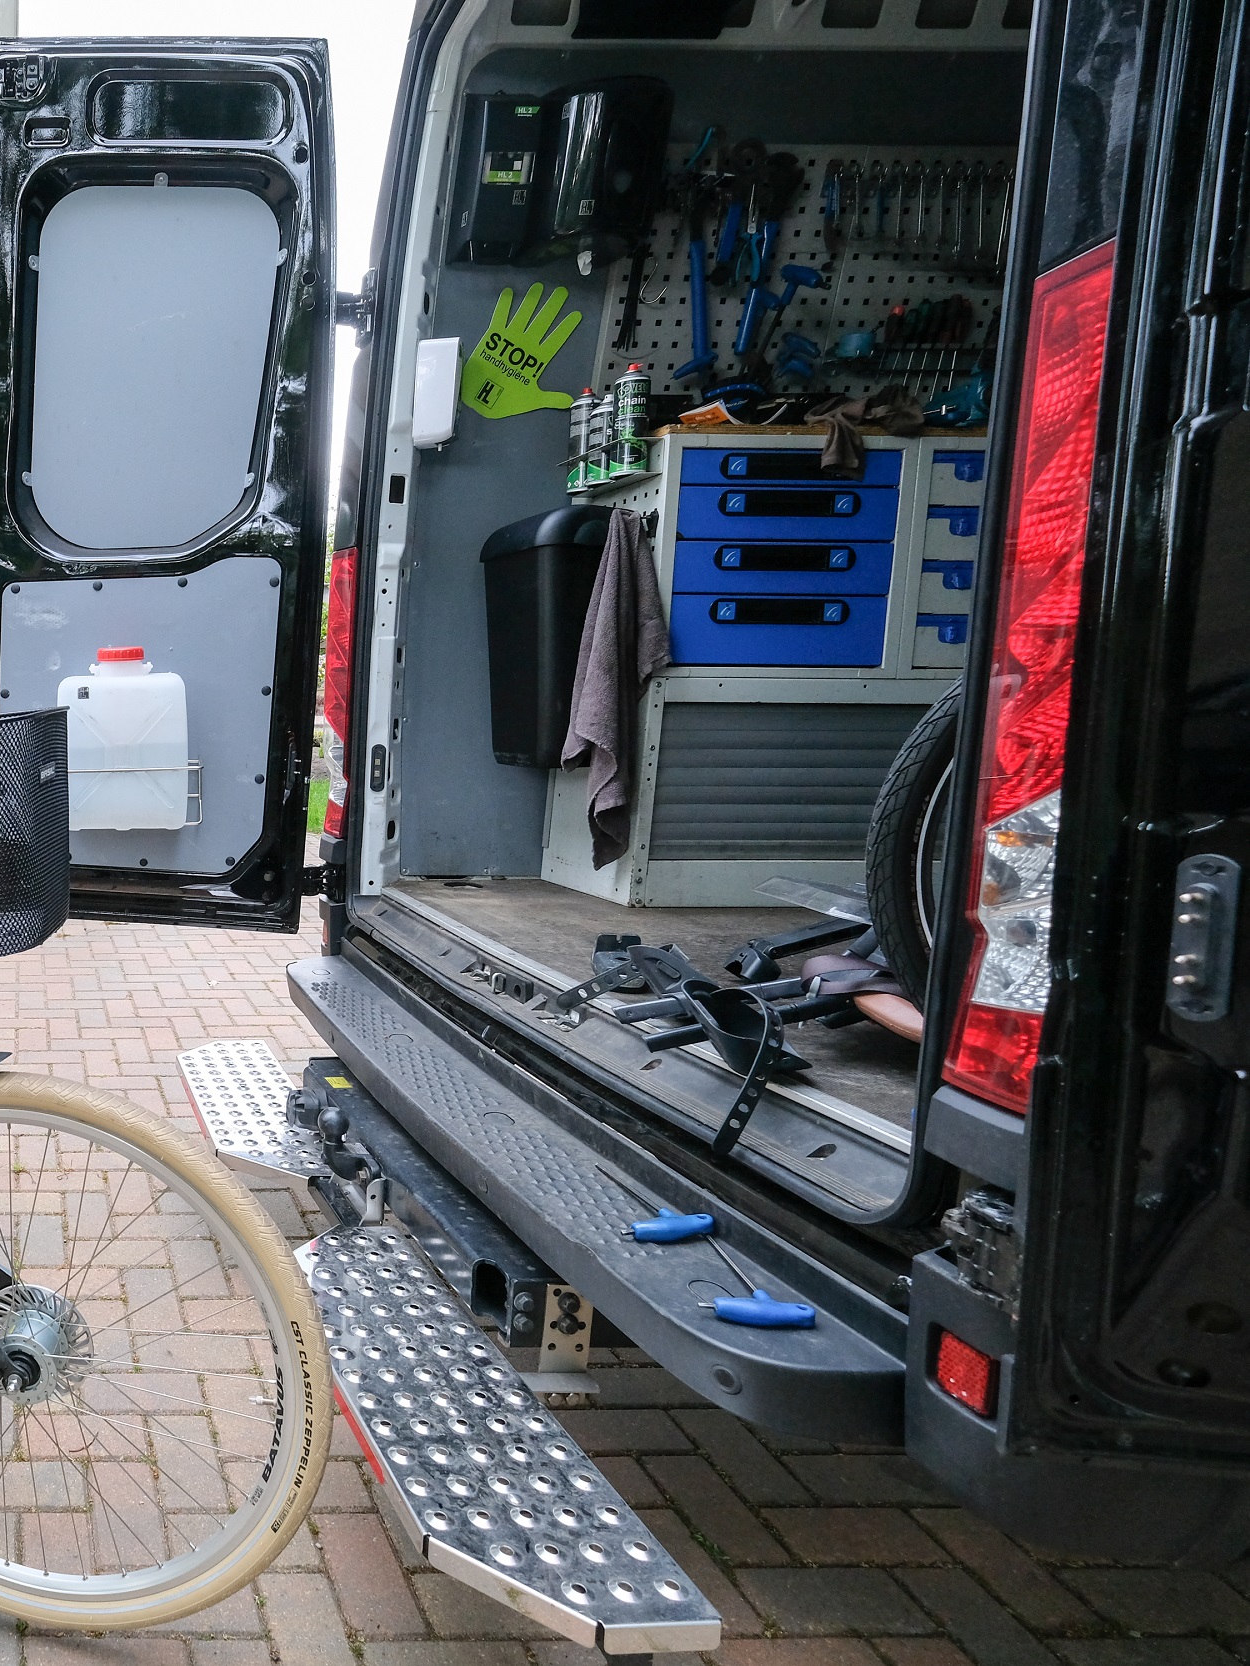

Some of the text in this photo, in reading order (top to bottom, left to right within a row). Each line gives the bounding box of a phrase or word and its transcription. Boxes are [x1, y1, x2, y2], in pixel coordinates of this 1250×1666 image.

[479, 348, 531, 386] handhygiëne
[485, 332, 545, 378] STOP!
[617, 405, 646, 416] clean
[618, 395, 647, 407] chain
[261, 1364, 285, 1484] BATAVUS
[290, 1320, 314, 1489] CST CLASSIC ZEPPELIN
